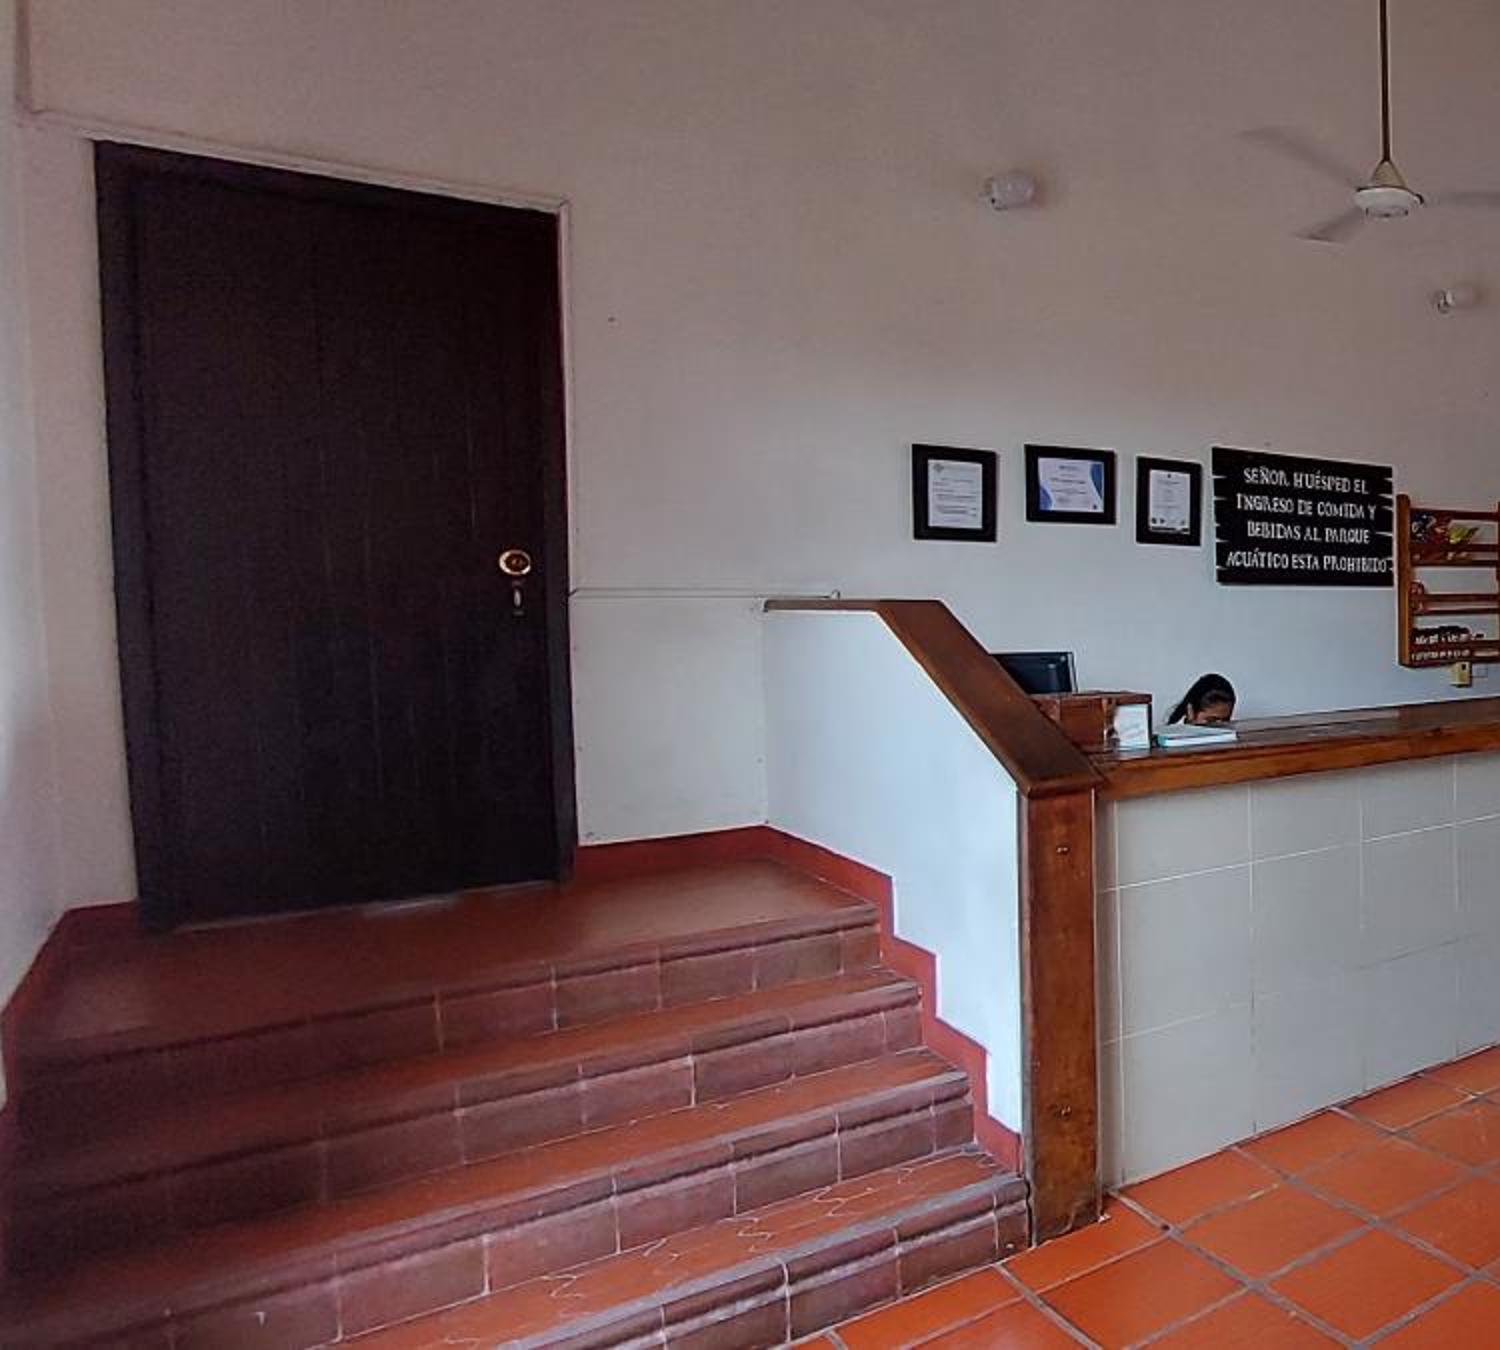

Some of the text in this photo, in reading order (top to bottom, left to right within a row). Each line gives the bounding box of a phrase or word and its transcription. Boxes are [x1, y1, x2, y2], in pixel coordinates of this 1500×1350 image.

[1243, 466, 1369, 495] SEÑOR HUÉSPED EL
[1236, 492, 1377, 520] INGRESO DE COMIDA Y
[1247, 520, 1371, 544] BEBIDAS AL PARQUE
[1226, 547, 1387, 573] ACUÁTICO ESTA PROHIBIDO
